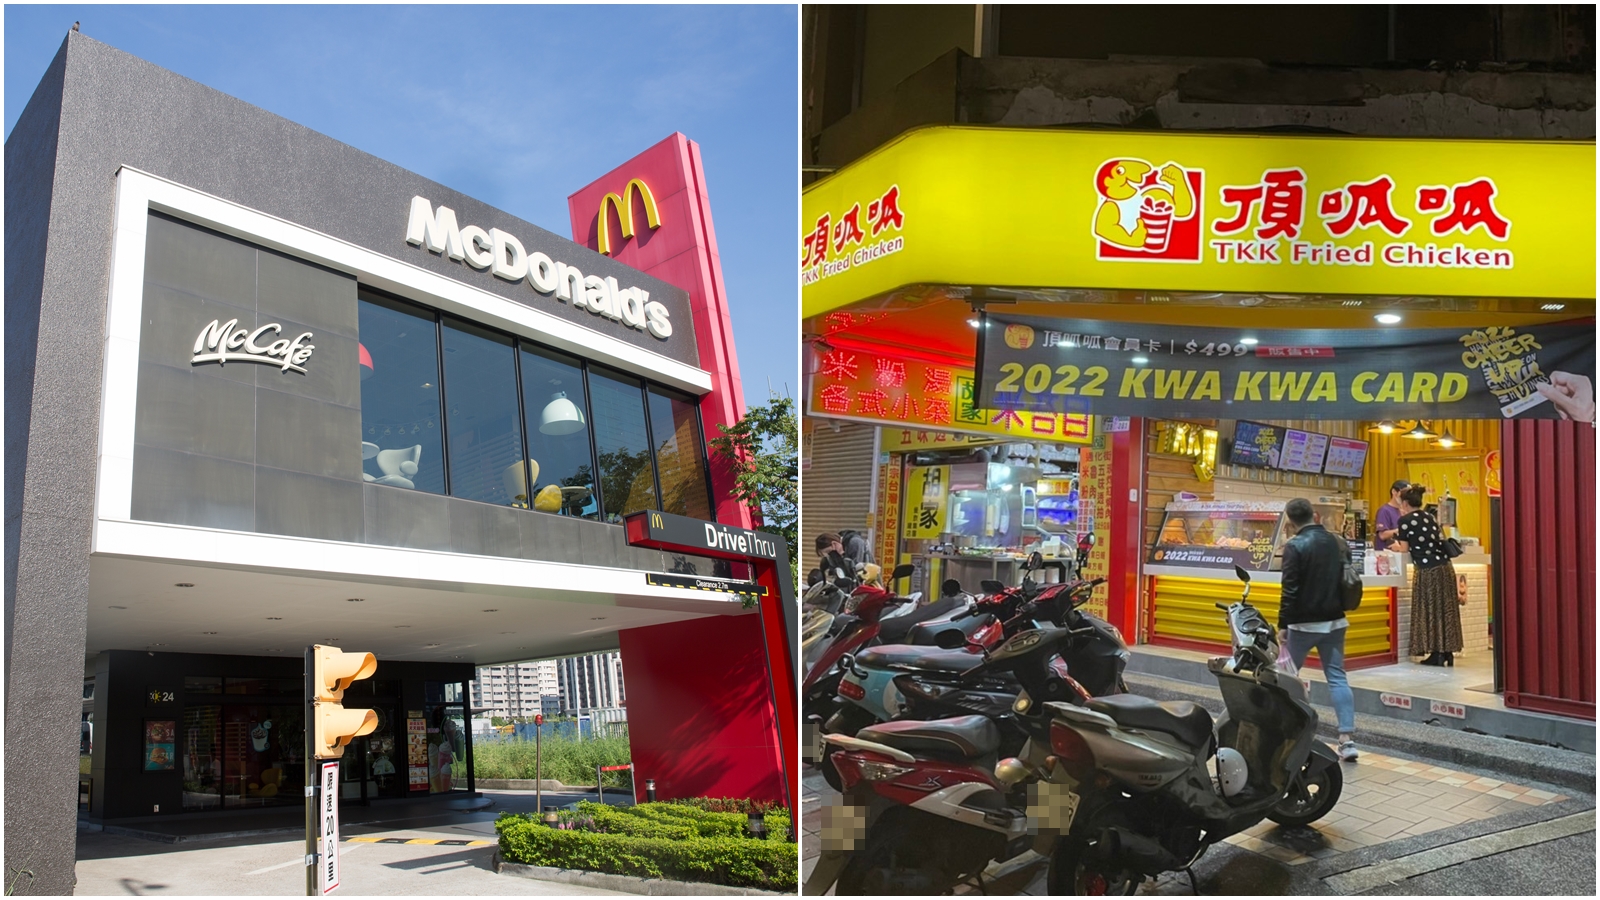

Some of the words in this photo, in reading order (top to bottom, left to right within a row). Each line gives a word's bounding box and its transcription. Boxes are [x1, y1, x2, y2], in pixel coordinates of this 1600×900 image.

[1213, 168, 1510, 241] 頂呱呱
[406, 195, 672, 339] McDonald's
[823, 254, 850, 277] Fried
[853, 238, 903, 265] Chicken
[1212, 241, 1279, 262] TKK
[1293, 243, 1371, 264] Fried
[1384, 244, 1511, 267] Chicken
[192, 318, 315, 371] McCafé
[1184, 339, 1248, 357] $499
[995, 362, 1109, 398] 2022
[1118, 367, 1222, 401] KWA
[1233, 371, 1338, 402] KWA
[1351, 371, 1469, 403] CARD
[919, 467, 941, 529] 胡家
[162, 691, 175, 702] 24
